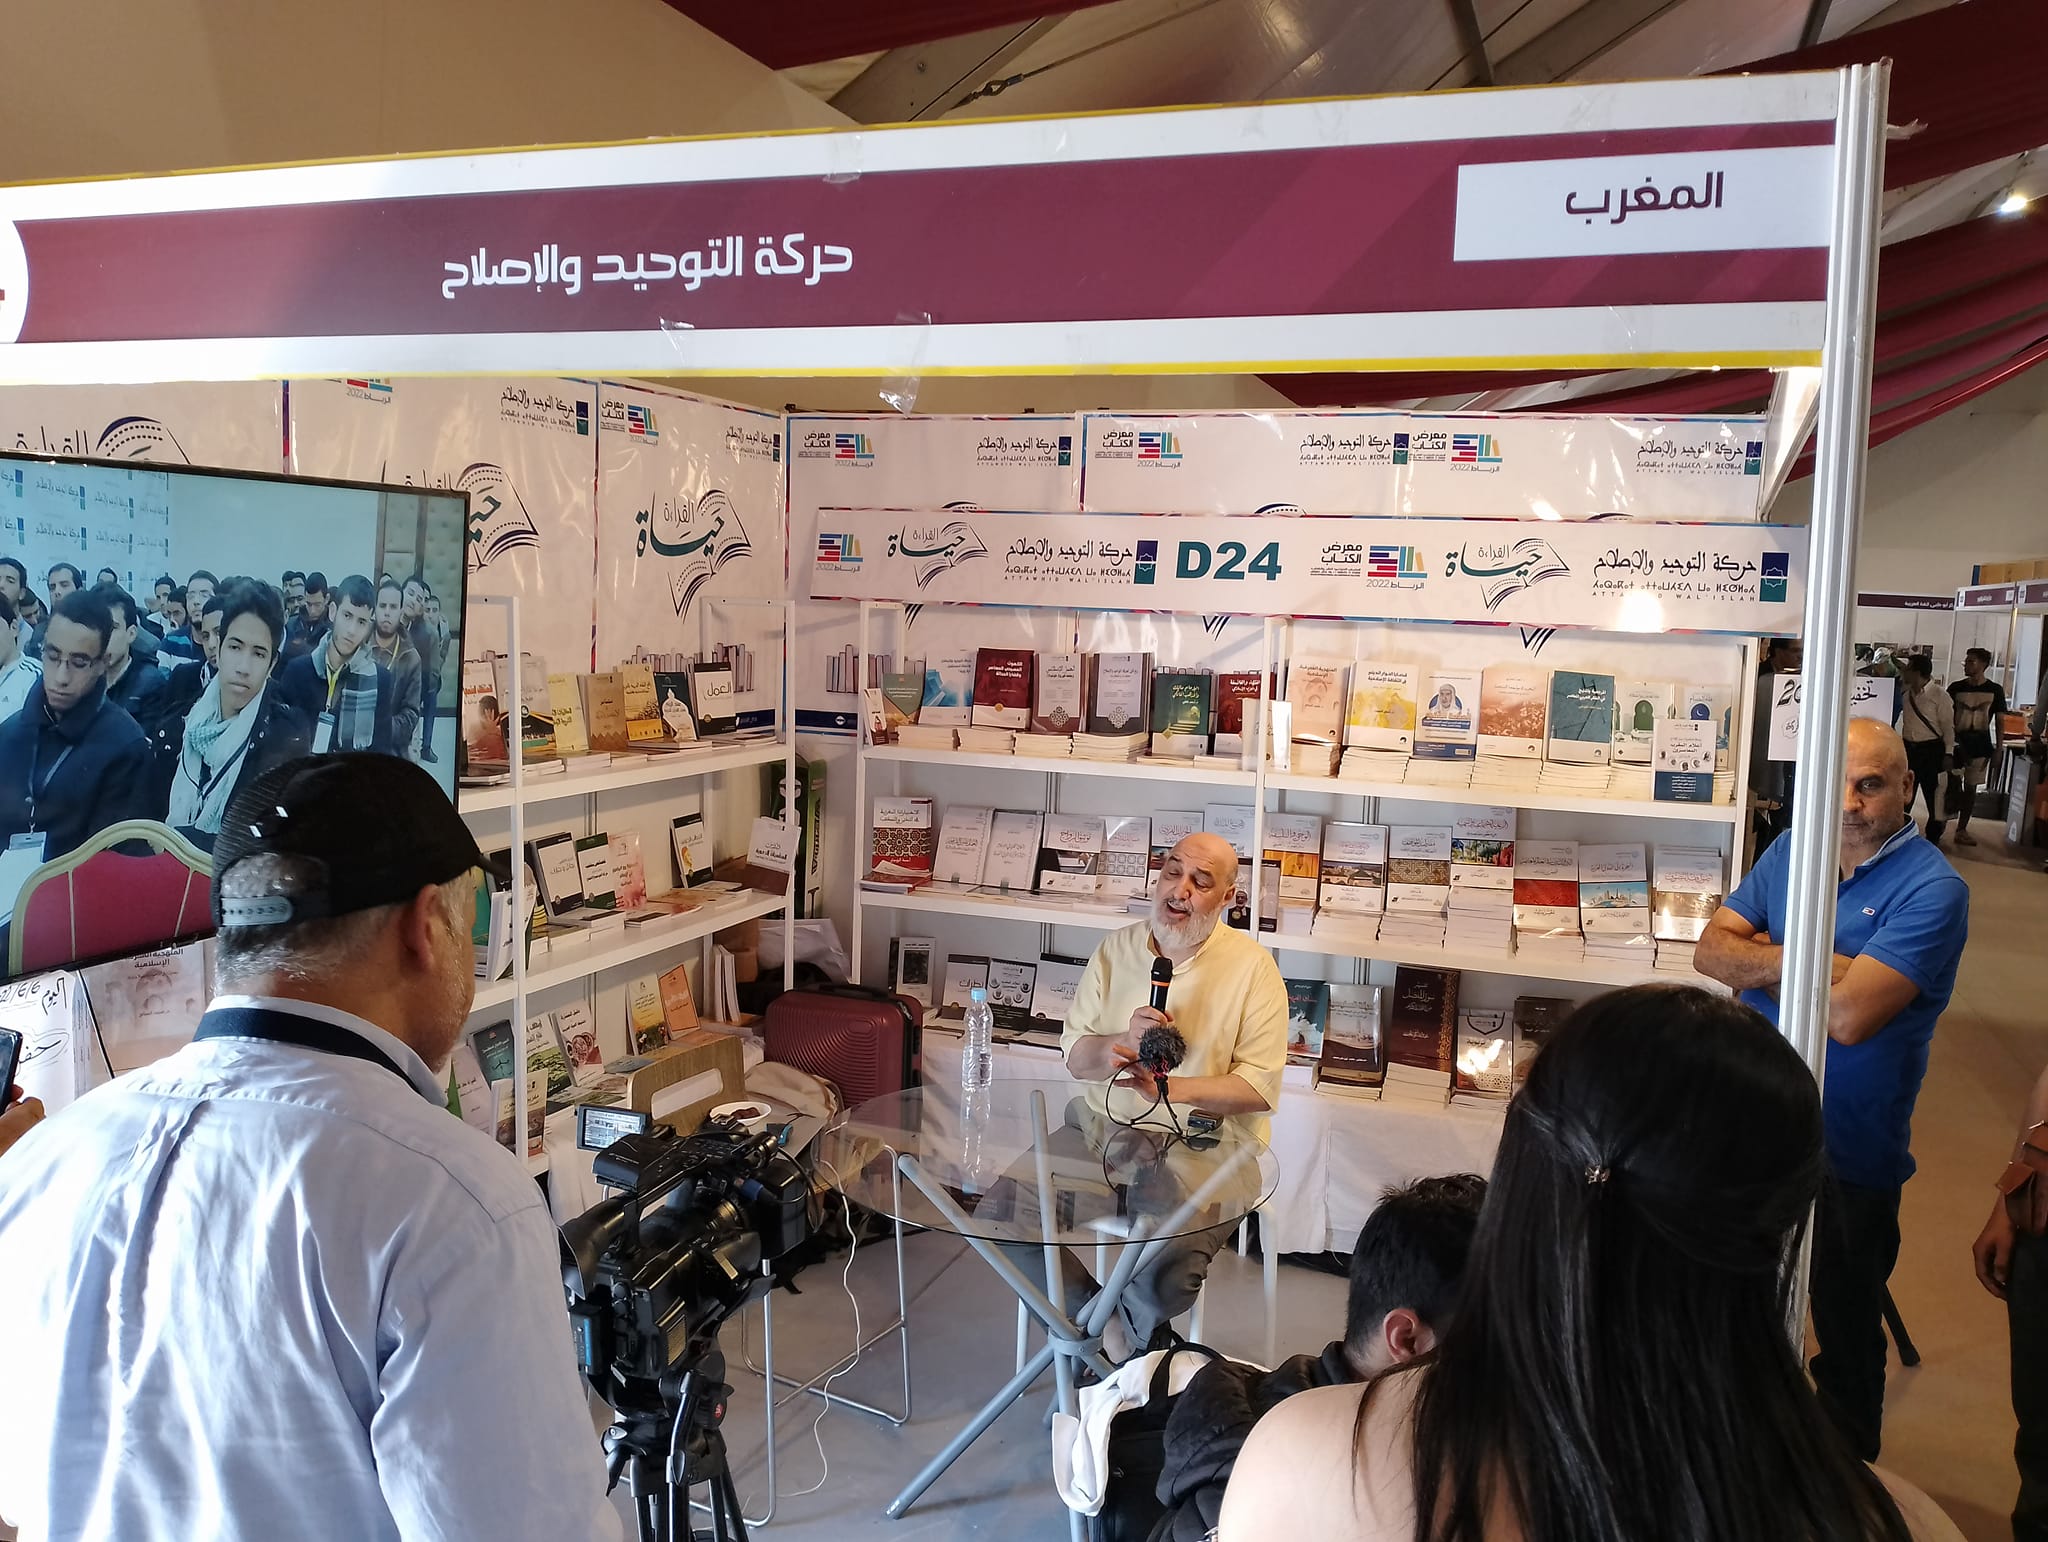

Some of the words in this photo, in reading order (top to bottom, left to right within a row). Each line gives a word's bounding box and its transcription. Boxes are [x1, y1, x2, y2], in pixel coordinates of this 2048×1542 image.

[1565, 171, 1724, 225] المغرب
[592, 235, 743, 291] التوحيد
[754, 232, 853, 286] حركة
[441, 244, 581, 299] والإصلاح
[1103, 429, 1134, 440] معرض
[1338, 433, 1365, 451] التوحيد
[1367, 434, 1392, 453] حركة
[1412, 430, 1447, 441] معرض
[1035, 437, 1057, 455] حركة
[1102, 440, 1133, 450] الكتاب
[1412, 441, 1447, 451] الكتاب
[1714, 441, 1744, 462] حركة
[912, 528, 939, 543] القراءة
[1058, 540, 1094, 562] التوحيد
[1098, 541, 1133, 566] حركة
[1322, 541, 1363, 553] معرض
[1478, 544, 1510, 561] القراءة
[1175, 541, 1282, 581] D24
[1321, 554, 1362, 565] الكتاب
[1446, 541, 1543, 577] حياة
[1660, 550, 1706, 576] التوحيد
[1713, 552, 1757, 581] حركة
[1366, 579, 1390, 588] 2022
[1390, 582, 1424, 590] الرباط
[706, 681, 732, 697] العمل
[1850, 680, 1878, 706] تخفي
